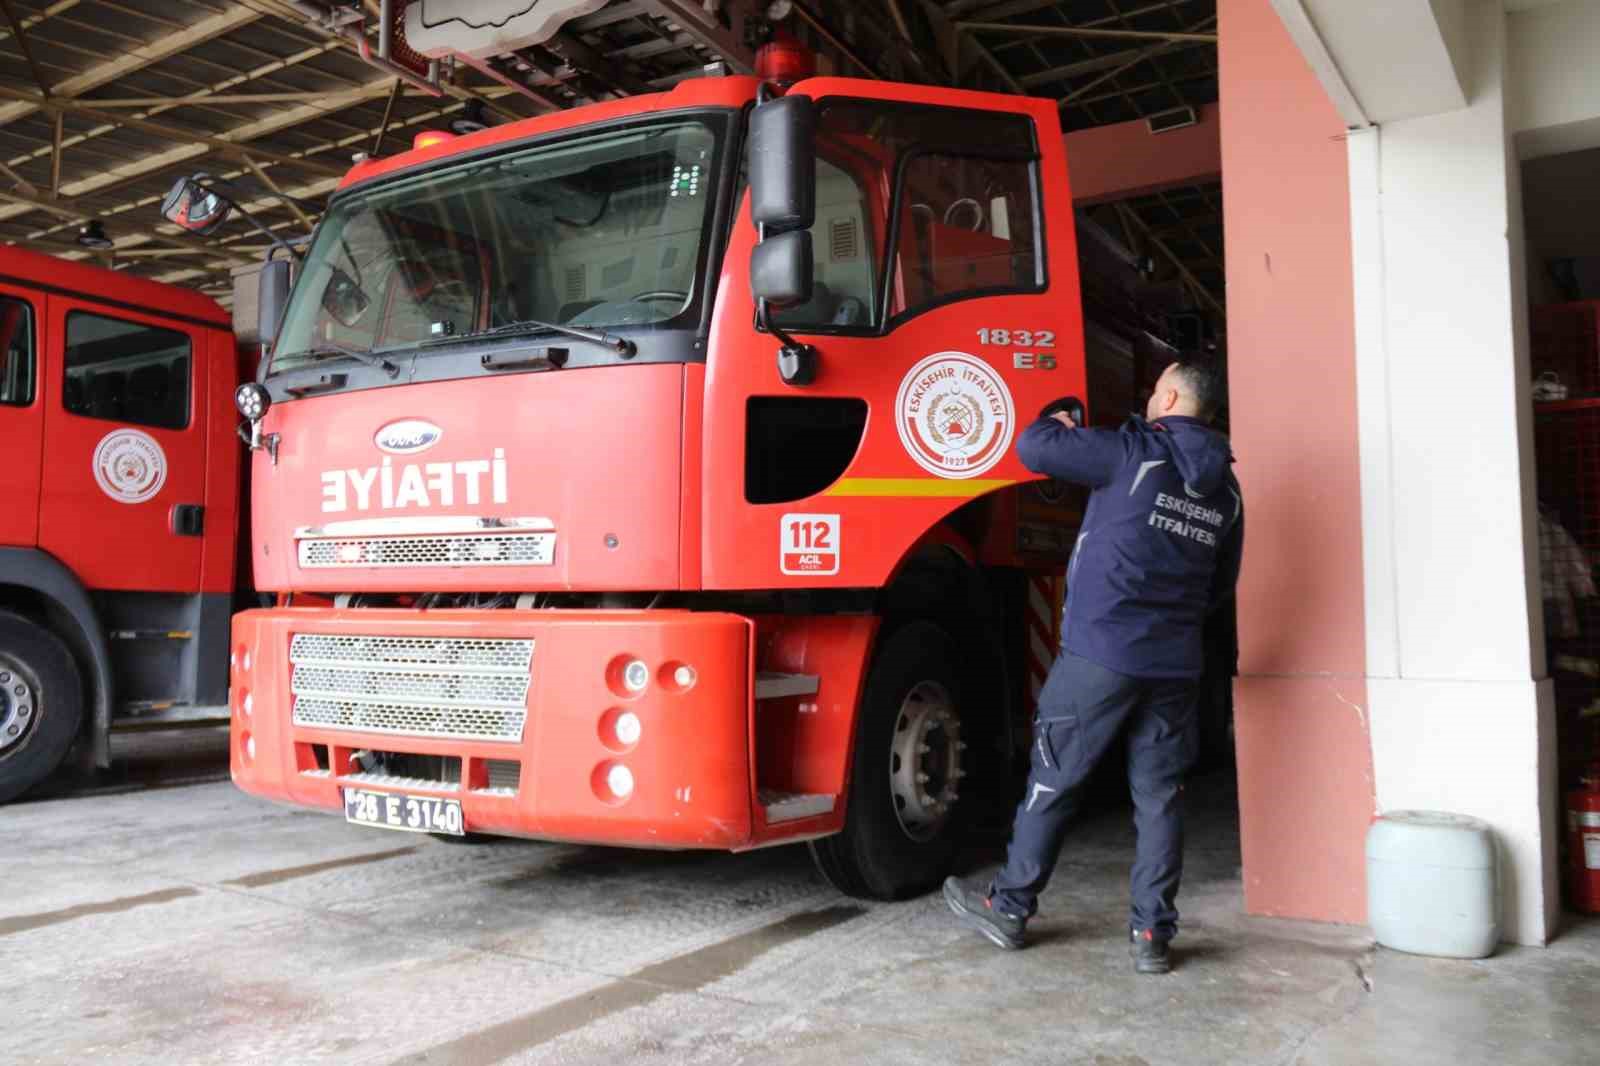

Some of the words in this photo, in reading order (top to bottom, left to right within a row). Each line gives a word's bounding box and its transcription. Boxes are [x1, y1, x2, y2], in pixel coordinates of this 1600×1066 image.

[976, 328, 1056, 348] 1832
[1013, 352, 1058, 370] E5
[944, 456, 966, 467] 1927
[1154, 492, 1224, 528] ESKİŞEHİR
[790, 521, 831, 548] 112
[386, 797, 402, 825] E
[406, 799, 459, 832] 3140
